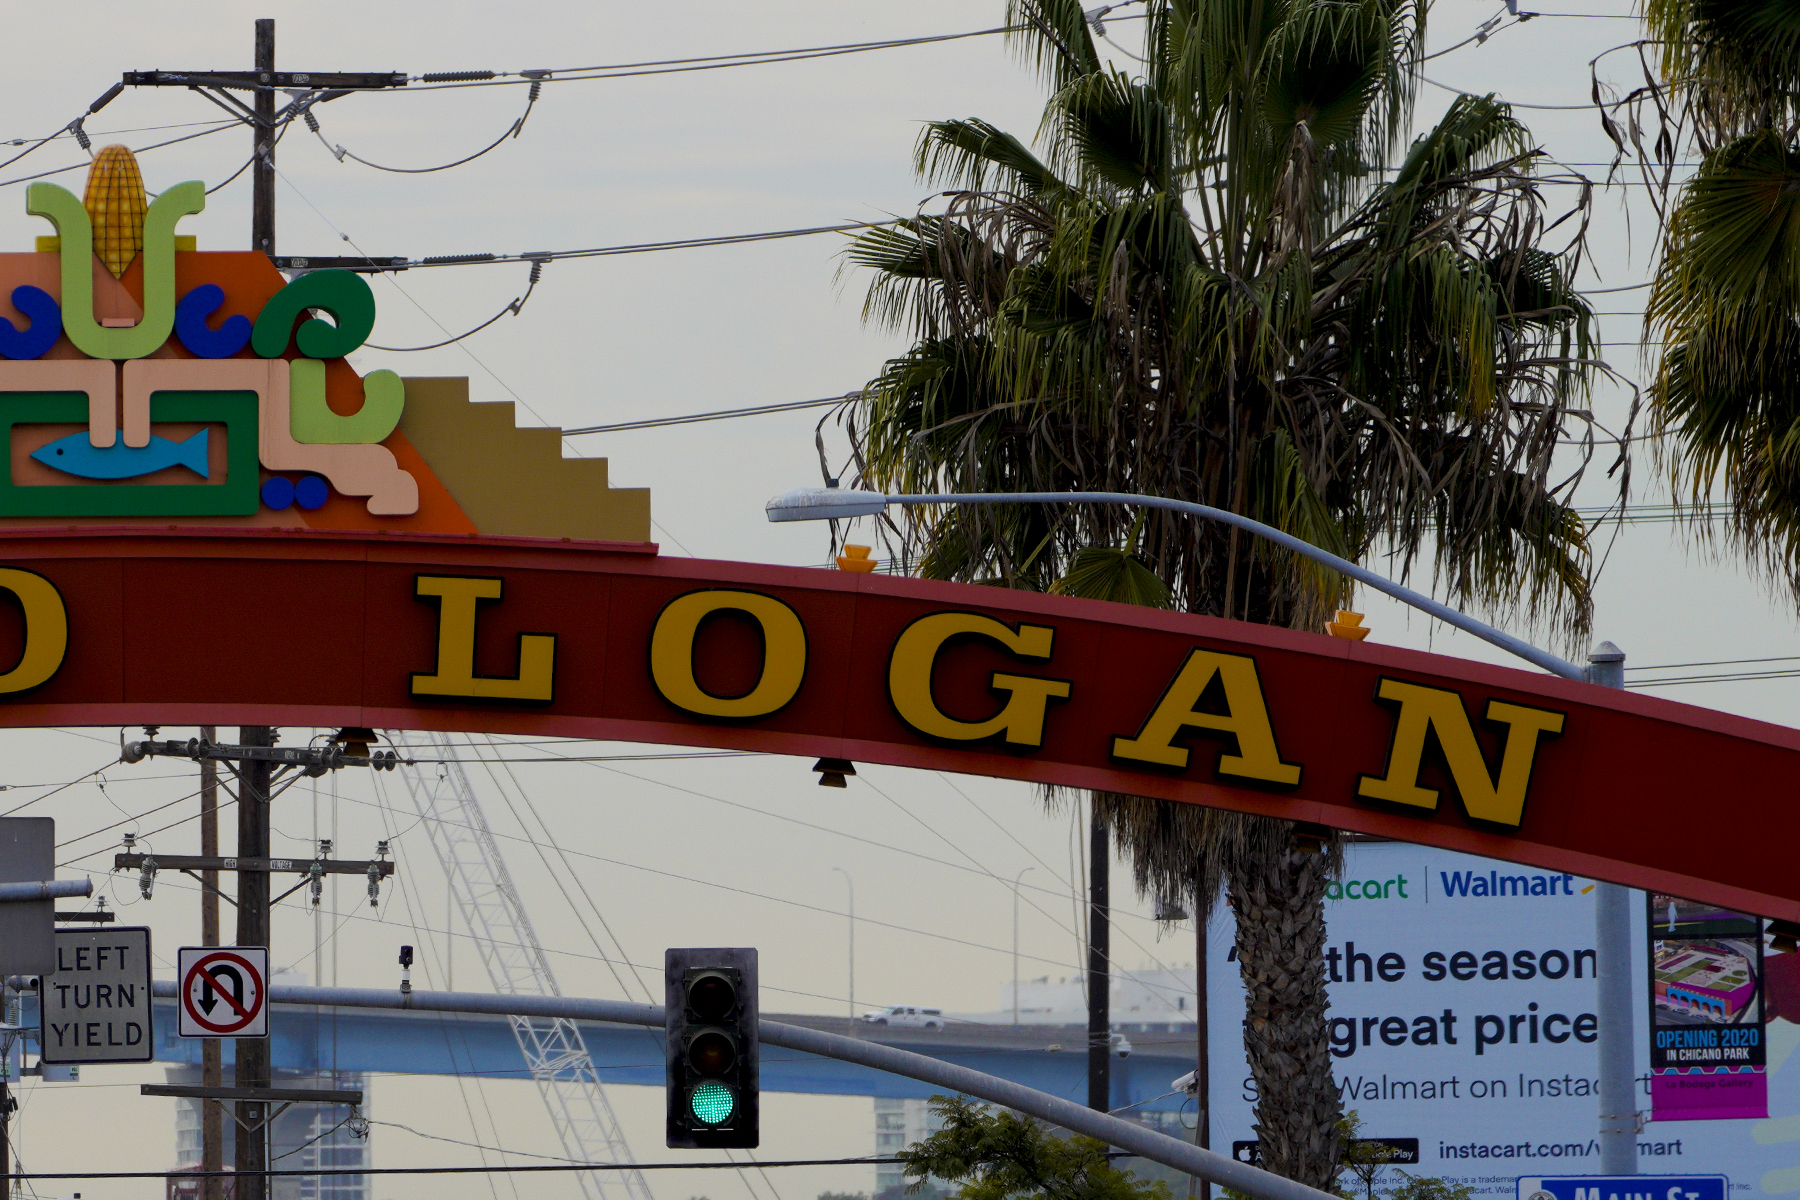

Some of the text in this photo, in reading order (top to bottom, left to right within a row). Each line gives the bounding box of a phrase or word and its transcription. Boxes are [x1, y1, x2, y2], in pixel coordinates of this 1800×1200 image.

[409, 573, 1566, 831] LOGAN
[1326, 869, 1574, 900] acart Walmart
[58, 946, 129, 971] LEFT
[55, 984, 135, 1009] TURN
[51, 1022, 142, 1047] YIELD
[1657, 1028, 1759, 1048] OPENING 2020
[1666, 1047, 1750, 1061] IN CHICANO PARK
[1470, 1078, 1507, 1099] on
